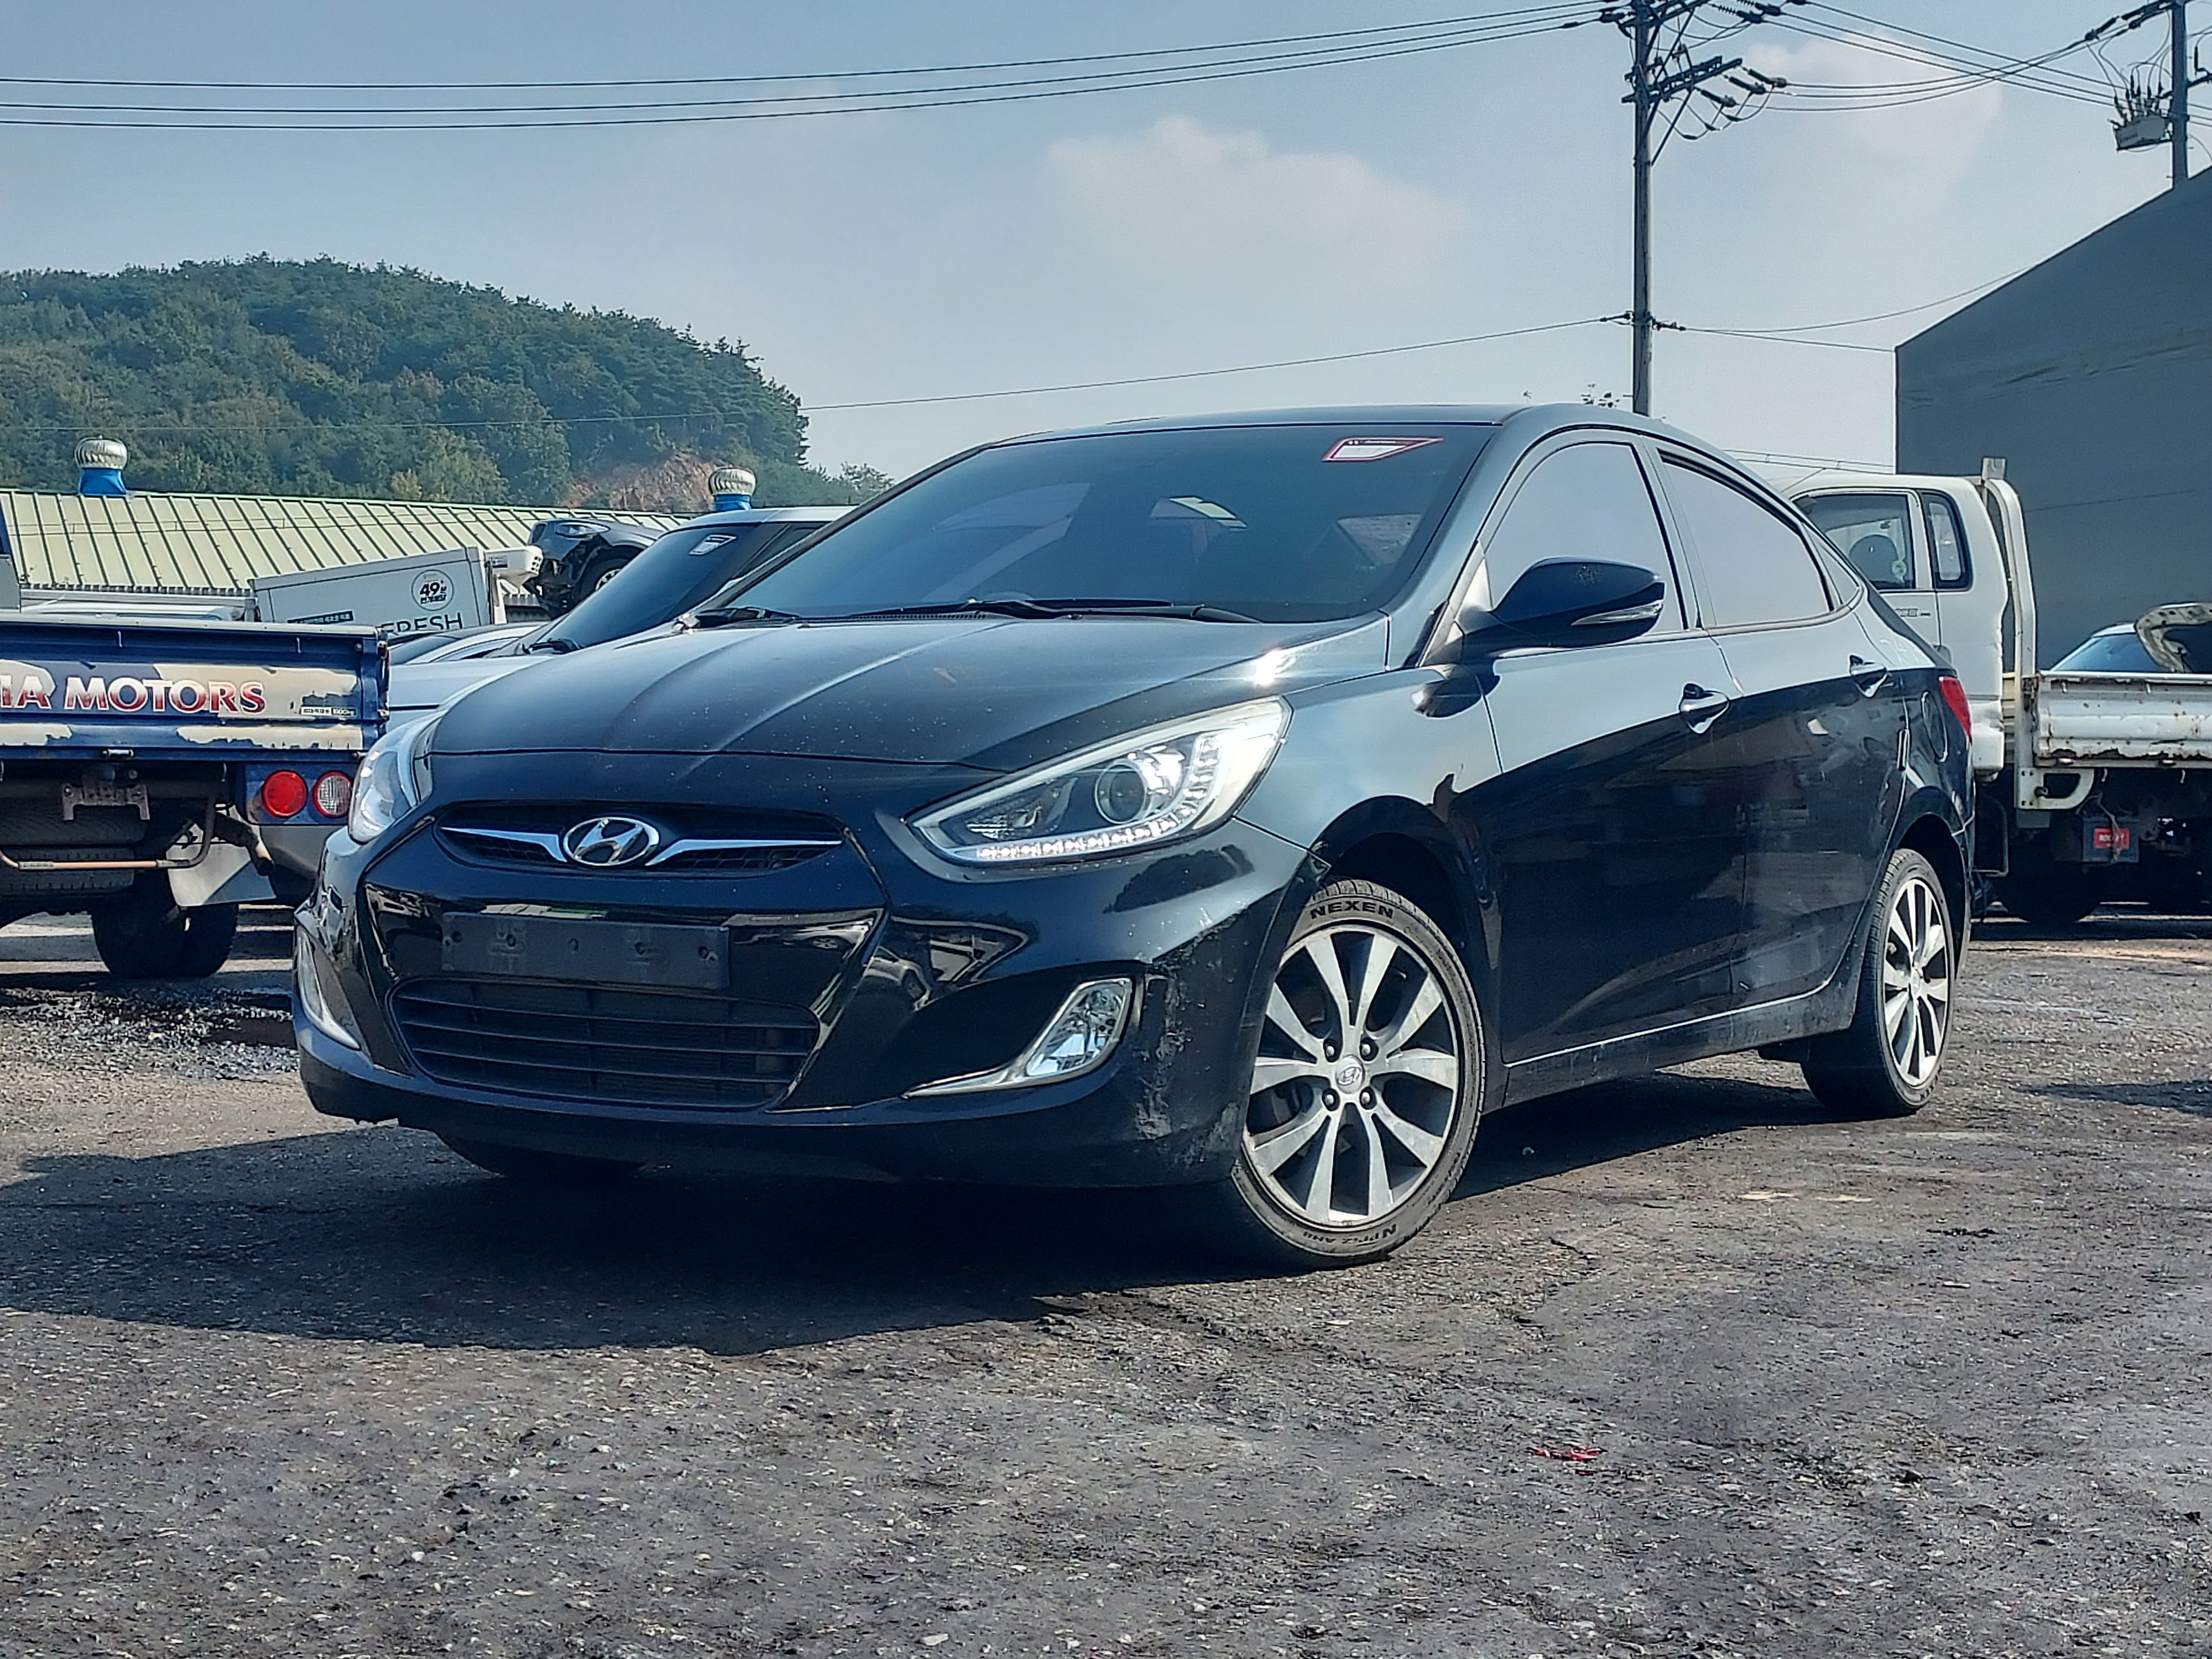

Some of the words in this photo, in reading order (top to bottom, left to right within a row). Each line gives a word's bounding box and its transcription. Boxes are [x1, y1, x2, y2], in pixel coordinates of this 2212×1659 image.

[420, 582, 440, 596] 49
[381, 612, 462, 633] FRESH
[64, 676, 266, 714] MOTORS
[1310, 900, 1394, 919] NEXEN
